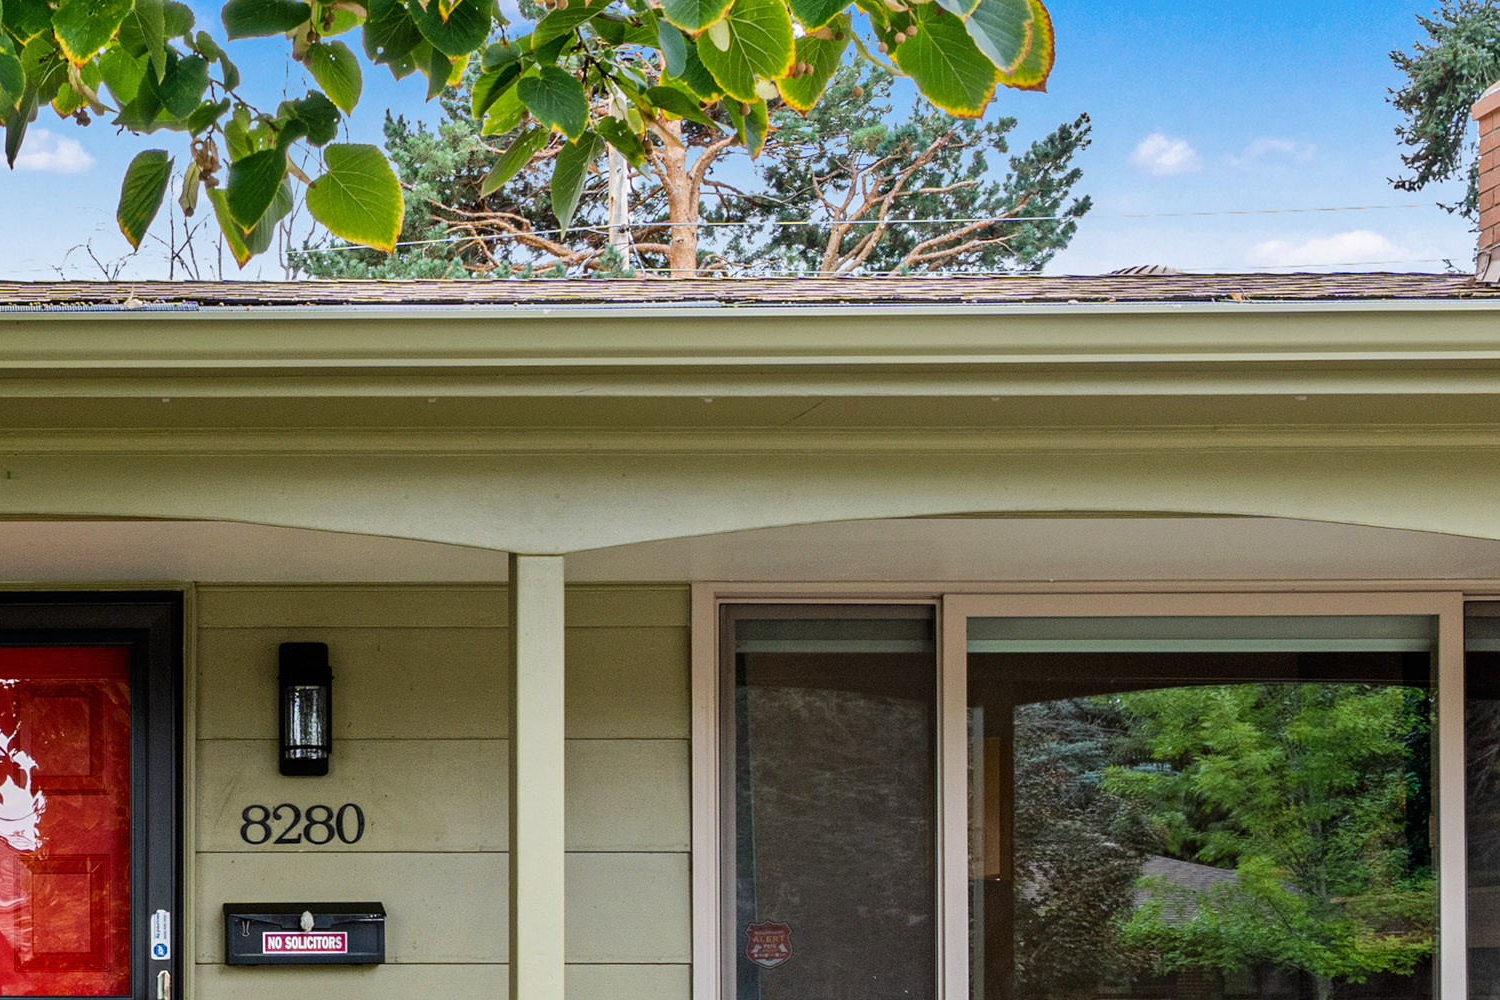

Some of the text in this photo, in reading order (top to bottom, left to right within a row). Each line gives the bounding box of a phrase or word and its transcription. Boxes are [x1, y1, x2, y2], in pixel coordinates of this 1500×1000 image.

[240, 803, 365, 845] 8280
[267, 936, 343, 949] NO SOLICITORS
